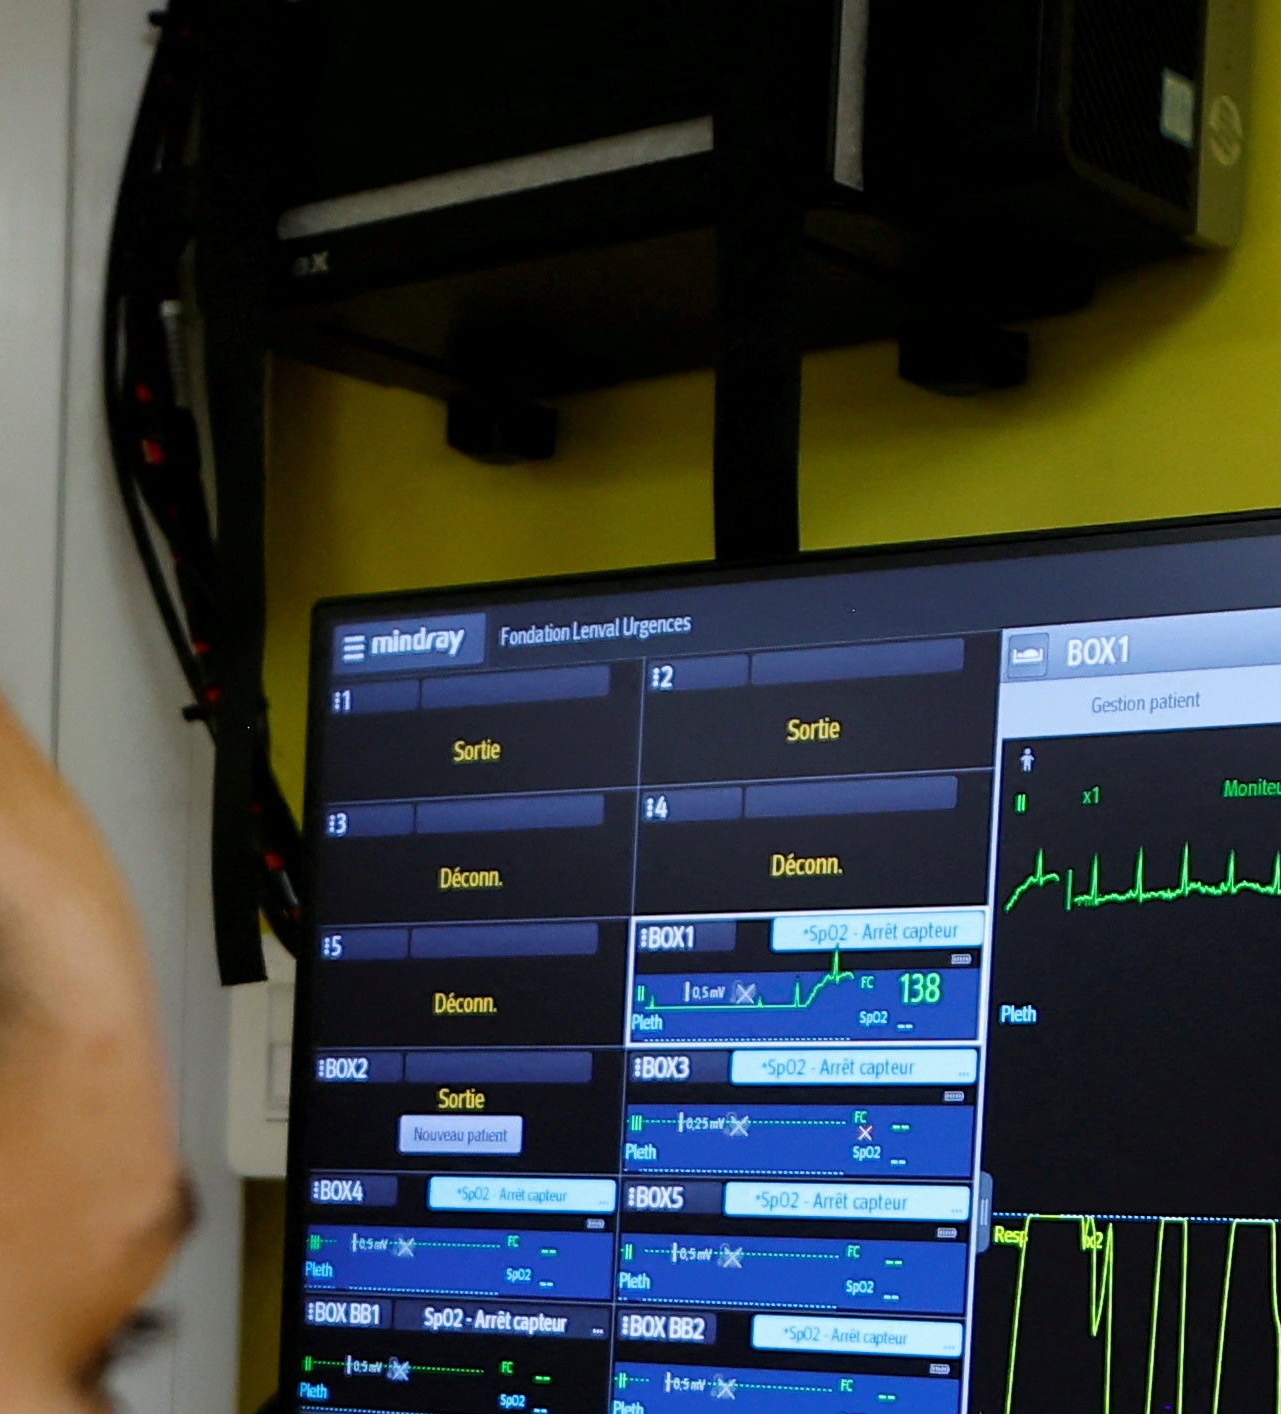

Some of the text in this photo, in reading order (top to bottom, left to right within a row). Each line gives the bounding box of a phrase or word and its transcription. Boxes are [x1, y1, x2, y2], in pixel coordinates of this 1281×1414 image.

[371, 627, 466, 656] mindray
[499, 615, 693, 648] Fondation Lenval Urgences
[1067, 635, 1130, 667] BOX1
[661, 664, 674, 688] 2
[1091, 691, 1201, 714] Gestion patient
[785, 717, 841, 743] Sortie
[453, 739, 501, 762] Sortie
[1082, 786, 1100, 804] x1
[655, 796, 669, 819] 4
[337, 812, 348, 835] 3
[770, 853, 844, 878] Déconn.
[439, 867, 504, 889] Déconn.
[331, 935, 343, 957] 5
[648, 926, 695, 949] BOX1
[862, 921, 903, 942] Arrêt
[904, 922, 959, 942] capteur
[860, 973, 942, 1004] FC 138
[433, 992, 498, 1013] Déconn.
[631, 1010, 889, 1031] Pleth SpO2
[1000, 1005, 1037, 1024] Pleth
[324, 1058, 369, 1080] BOX2
[643, 1056, 690, 1079] BOX3
[819, 1057, 860, 1076] Arrêt
[860, 1058, 915, 1079] capteur
[438, 1088, 486, 1110] Sortie
[854, 1111, 868, 1124] FC
[413, 1127, 508, 1145] Nouveau patient
[625, 1143, 881, 1161] Pleth SpO2
[319, 1180, 364, 1202] BOX4
[499, 1187, 527, 1202] Arrêt
[526, 1189, 567, 1205] capteur
[636, 1186, 684, 1209] BOX5
[813, 1192, 848, 1210] Arrêt
[852, 1193, 908, 1213] capteur
[507, 1235, 520, 1249] FC
[993, 1225, 1029, 1249] Resp
[846, 1245, 860, 1259] FC
[305, 1262, 532, 1283] Pleth SpO2
[618, 1272, 875, 1296] Pleth SpO2
[314, 1302, 567, 1336] BOX BB1 SpO2 Arrêt capteur
[630, 1314, 666, 1339] BOX
[668, 1315, 706, 1341] BB2
[830, 1326, 863, 1344] Arrêt
[863, 1327, 908, 1347] capteur
[501, 1361, 514, 1374] FC
[299, 1382, 526, 1408] Pleth SpO2
[840, 1378, 854, 1393] FC
